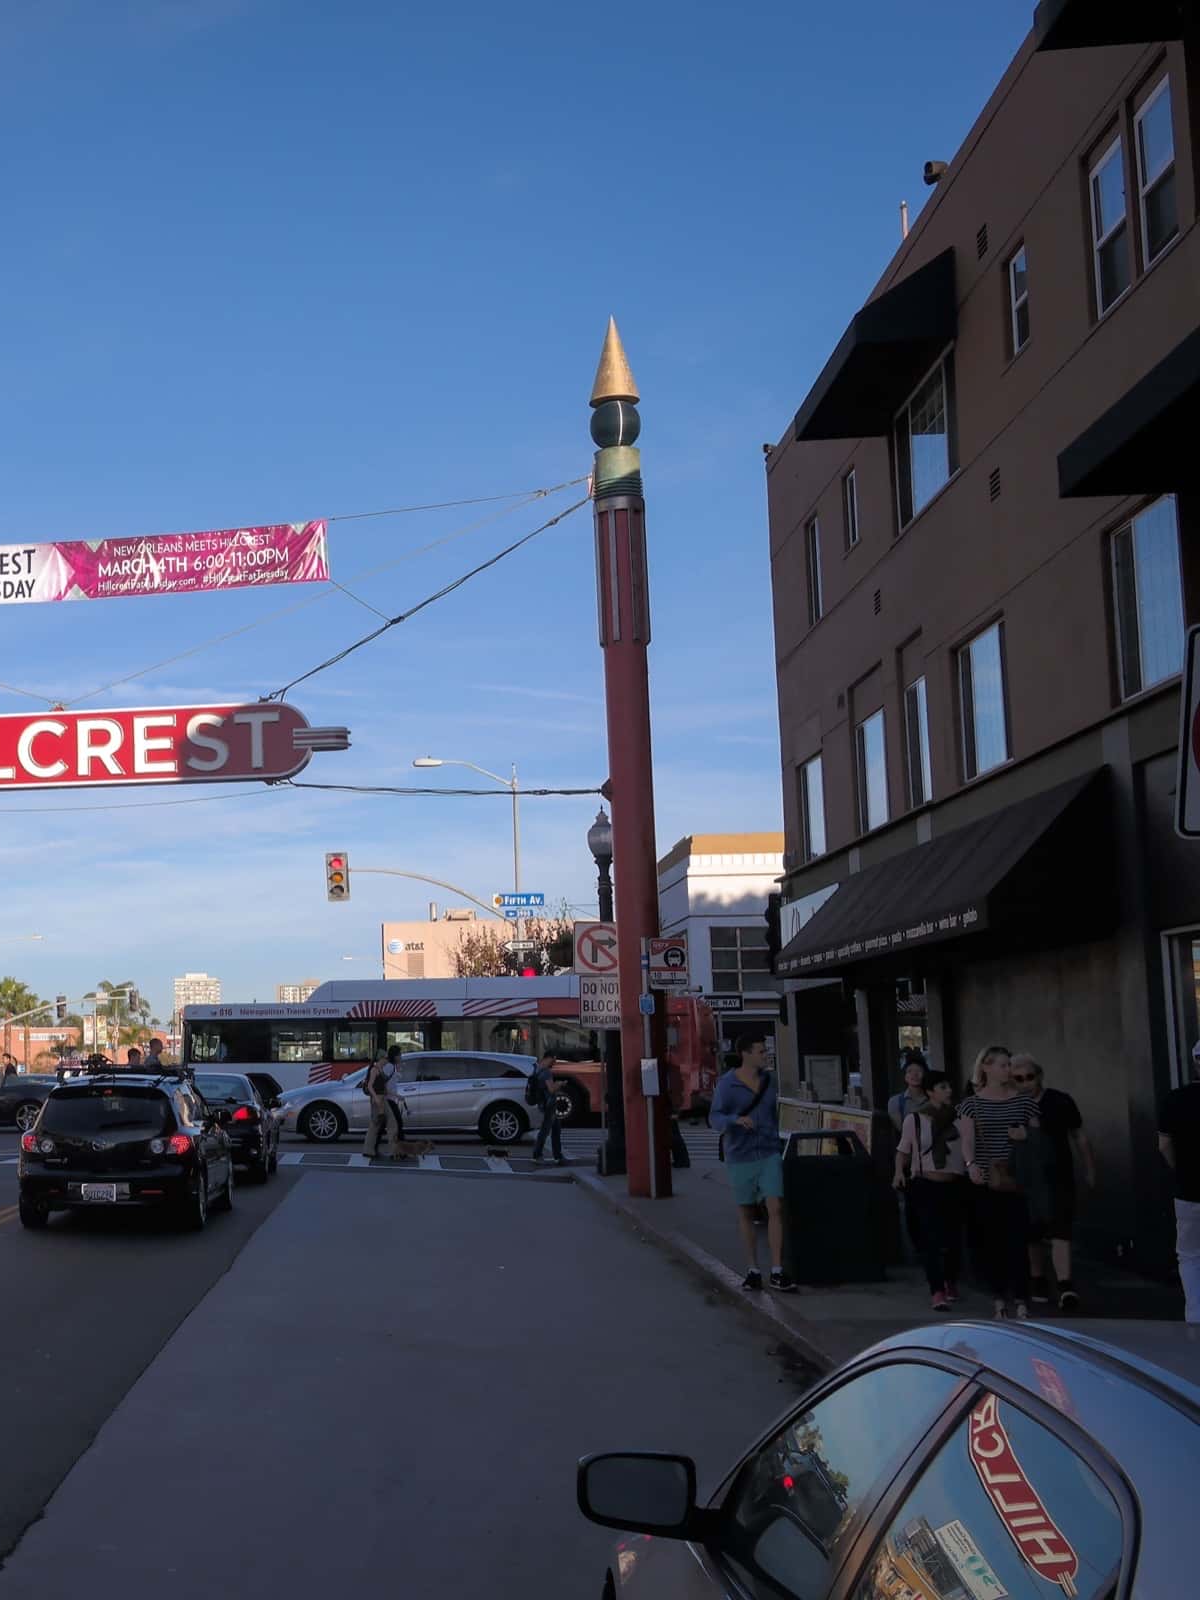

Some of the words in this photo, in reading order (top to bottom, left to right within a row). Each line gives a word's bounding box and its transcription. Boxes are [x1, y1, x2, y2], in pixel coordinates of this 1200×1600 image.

[113, 546, 135, 557] NEW
[186, 540, 217, 552] MEETS
[98, 558, 158, 578] MARCH
[158, 556, 188, 573] 4TH
[193, 547, 289, 572] 6:00-11:00PM
[504, 896, 527, 905] FIFTH
[583, 983, 596, 994] DO
[583, 1000, 620, 1012] BLOCK
[240, 1008, 285, 1017] Metropolitan
[287, 1008, 312, 1016] Transit
[313, 1008, 340, 1016] System
